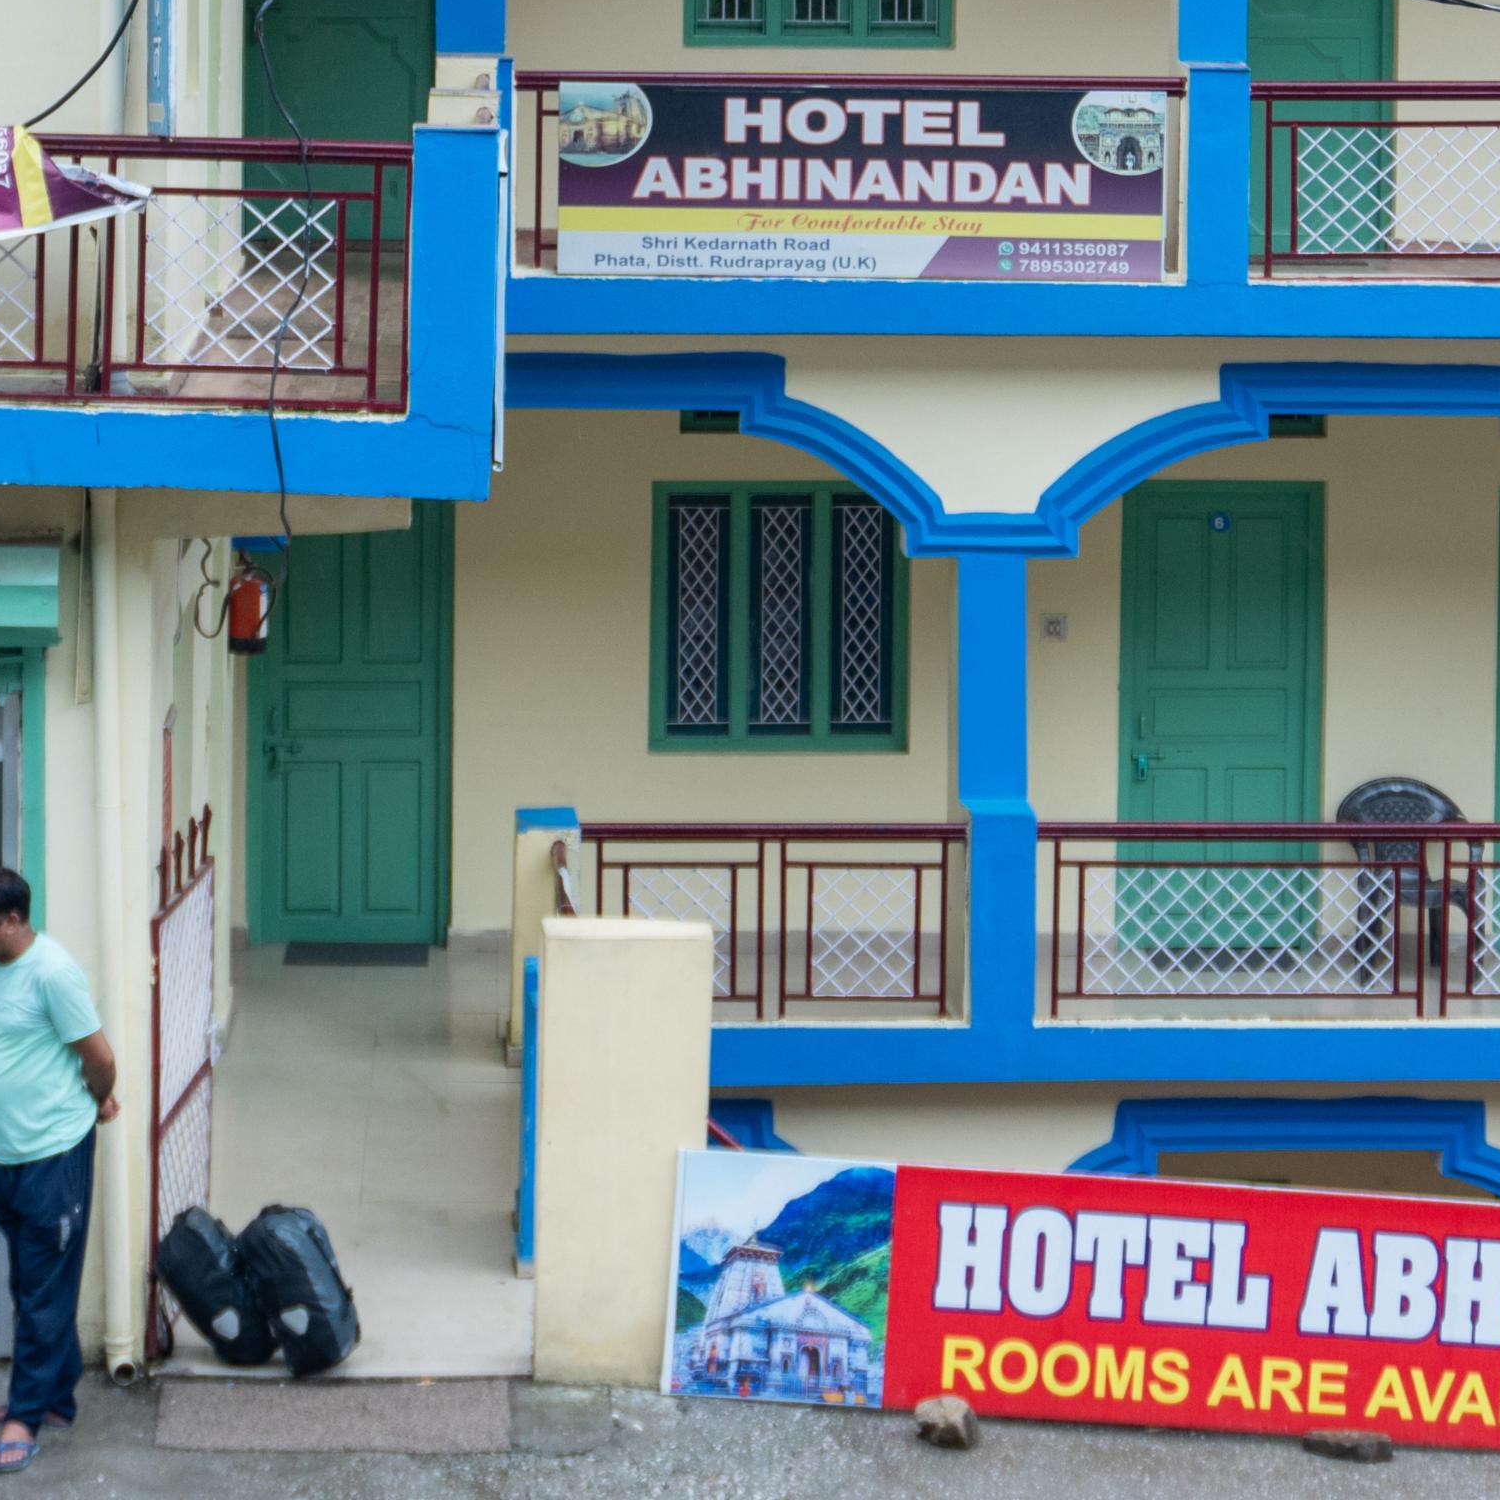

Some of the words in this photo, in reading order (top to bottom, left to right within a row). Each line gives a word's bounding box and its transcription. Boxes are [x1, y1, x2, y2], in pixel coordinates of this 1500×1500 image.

[724, 97, 1006, 148] HOTEL
[631, 156, 1092, 206] ABHINANDAN
[738, 212, 785, 232] For
[790, 212, 927, 233] Comfortable
[931, 215, 983, 234] Stay
[641, 236, 678, 250] Shri
[684, 236, 778, 251] Kedarnath
[784, 238, 831, 251] Road
[1019, 242, 1129, 257] 9411356087
[594, 254, 651, 268] Phata,
[656, 254, 703, 268] Distt.
[710, 255, 826, 271] Rudraprayag
[832, 256, 877, 272] (U.K)
[1019, 259, 1130, 274] 7895302749
[932, 1201, 1273, 1333] HOTEL
[941, 1335, 1191, 1405] ROOMS
[1206, 1353, 1349, 1417] ARE
